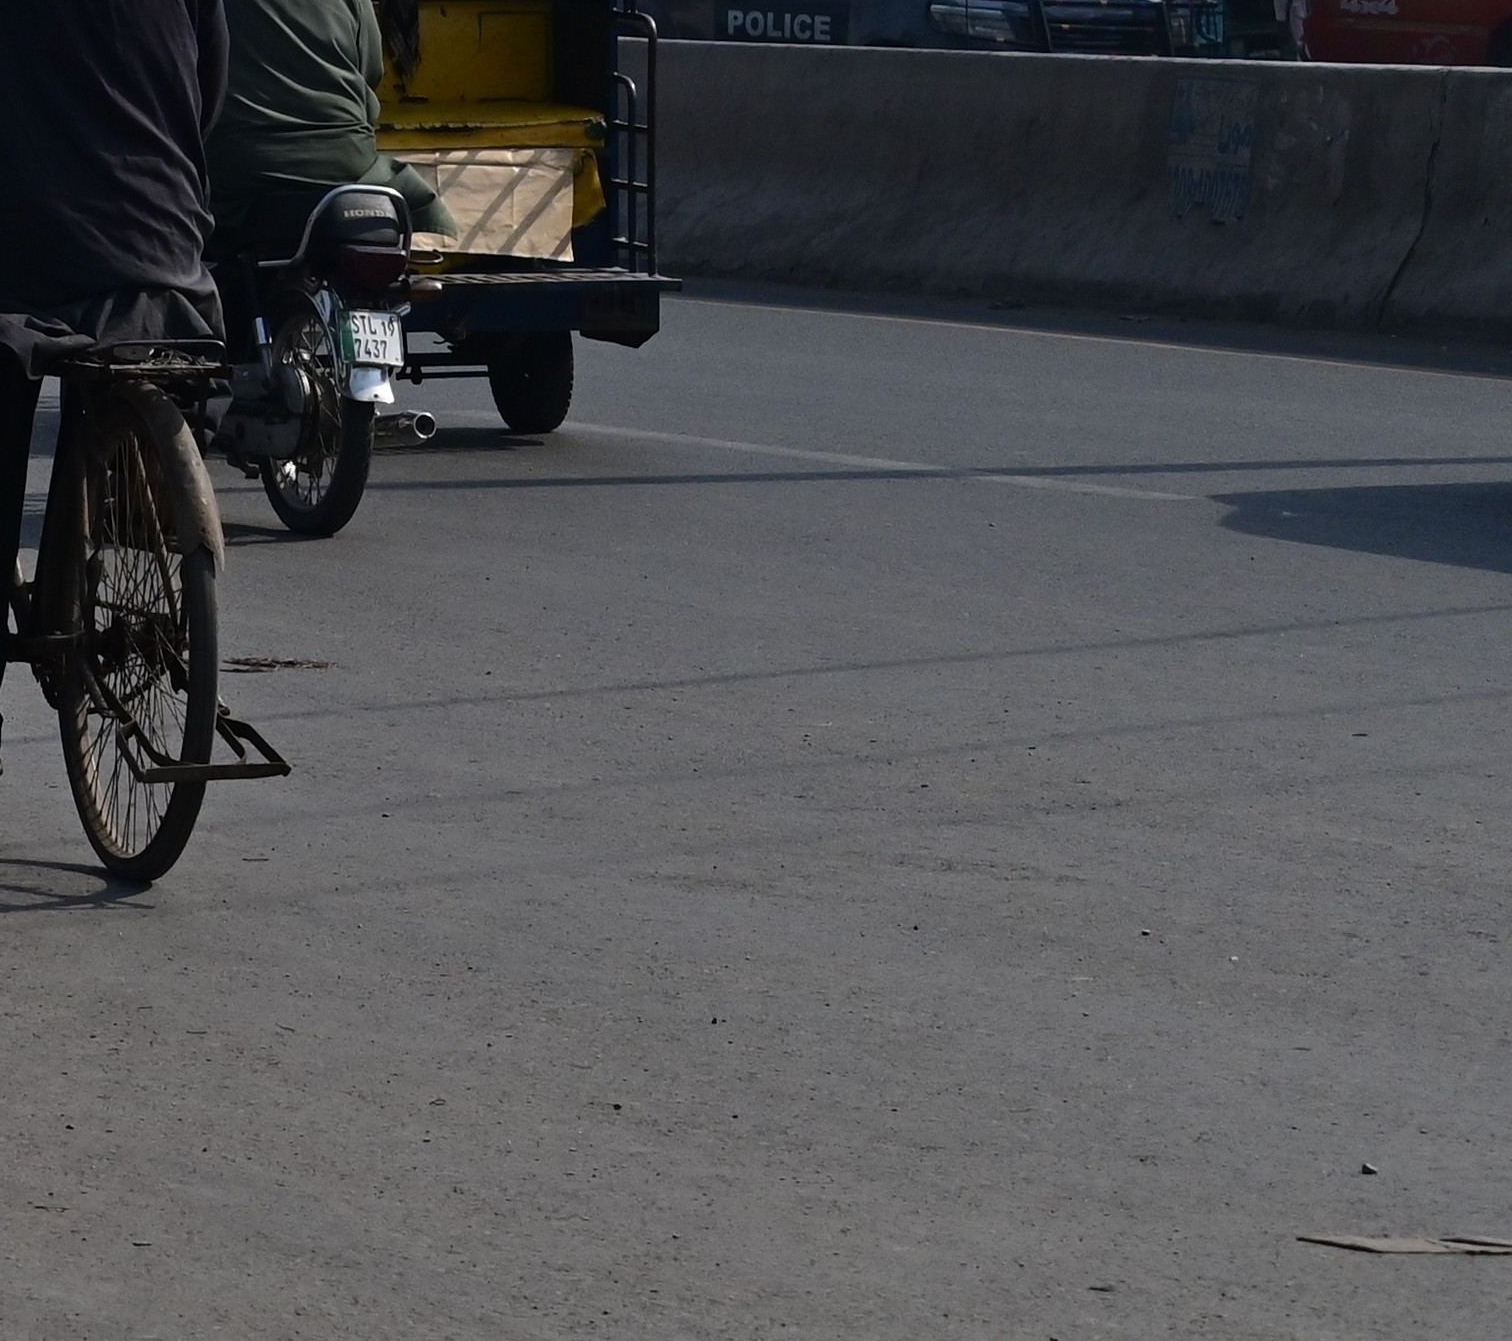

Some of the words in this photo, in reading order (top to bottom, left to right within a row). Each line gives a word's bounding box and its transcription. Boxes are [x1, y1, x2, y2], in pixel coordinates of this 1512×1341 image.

[727, 9, 832, 41] POLICE
[351, 315, 377, 334] STL
[354, 338, 387, 359] 7437
